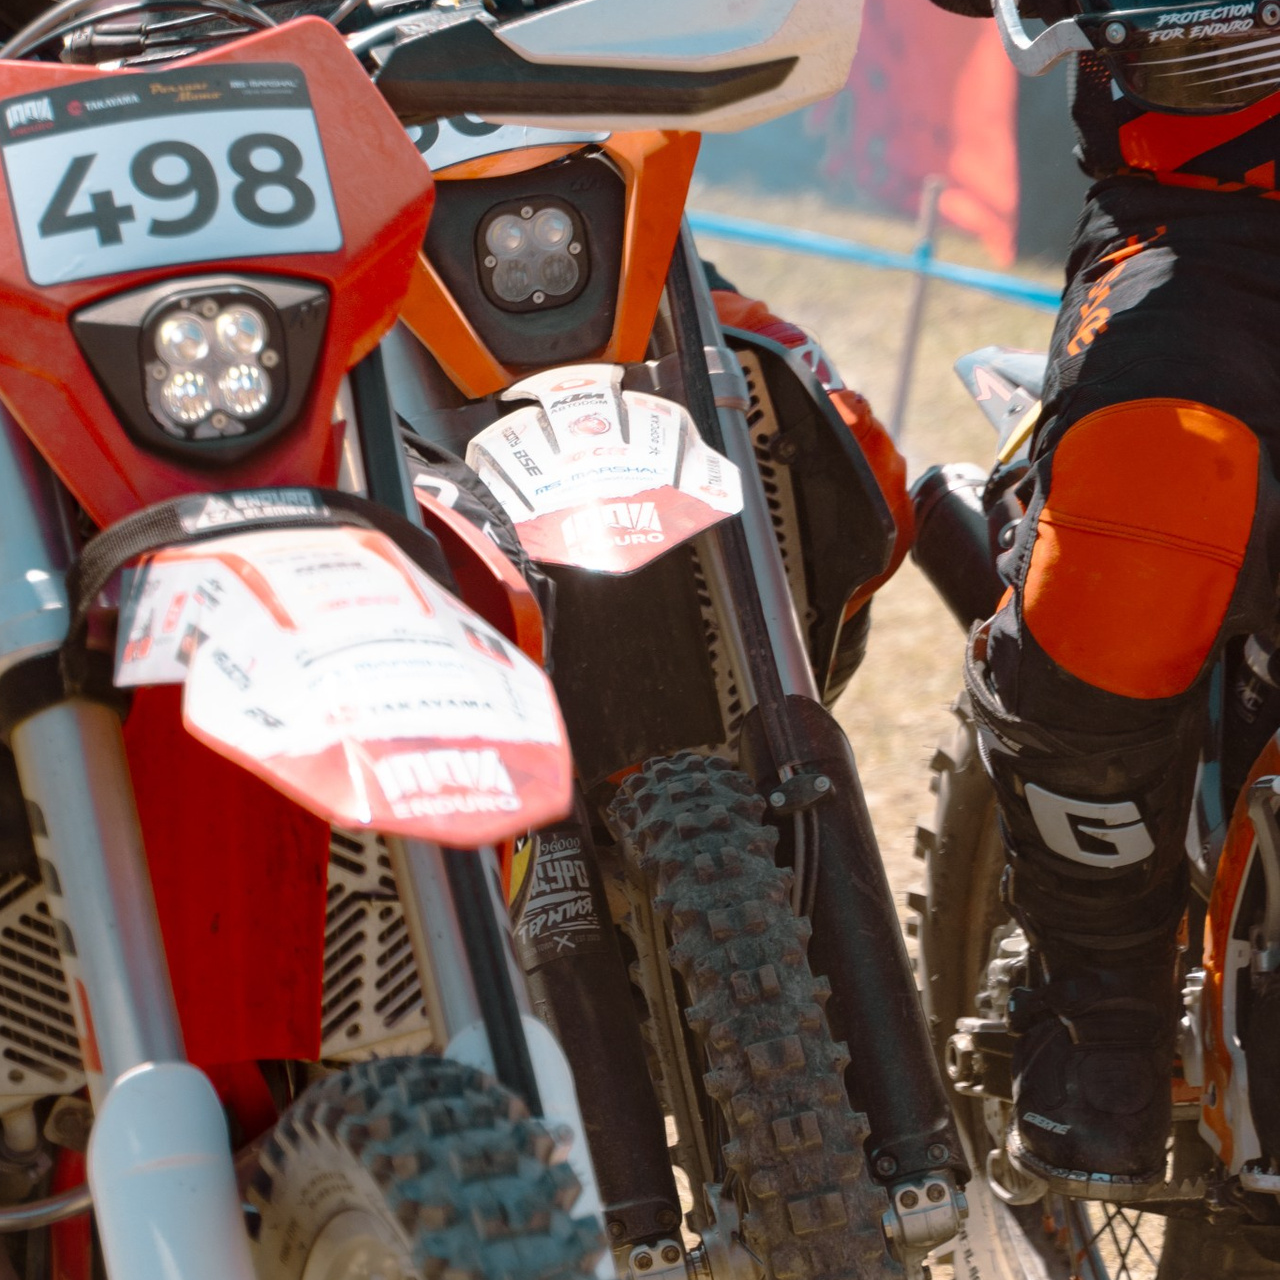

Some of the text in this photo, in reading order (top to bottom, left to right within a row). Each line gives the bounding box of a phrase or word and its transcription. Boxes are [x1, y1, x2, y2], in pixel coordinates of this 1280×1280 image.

[1156, 1, 1255, 28] PROTECTION
[1148, 18, 1254, 43] FOR ENDURO
[84, 93, 141, 112] TAKAYAMA
[37, 132, 316, 248] 498
[513, 449, 543, 478] BSE
[233, 488, 313, 509] ENDURO
[390, 794, 521, 819] ENDURO
[531, 860, 590, 898] ДУРО
[518, 896, 593, 945] ТЕРАПИЯ
